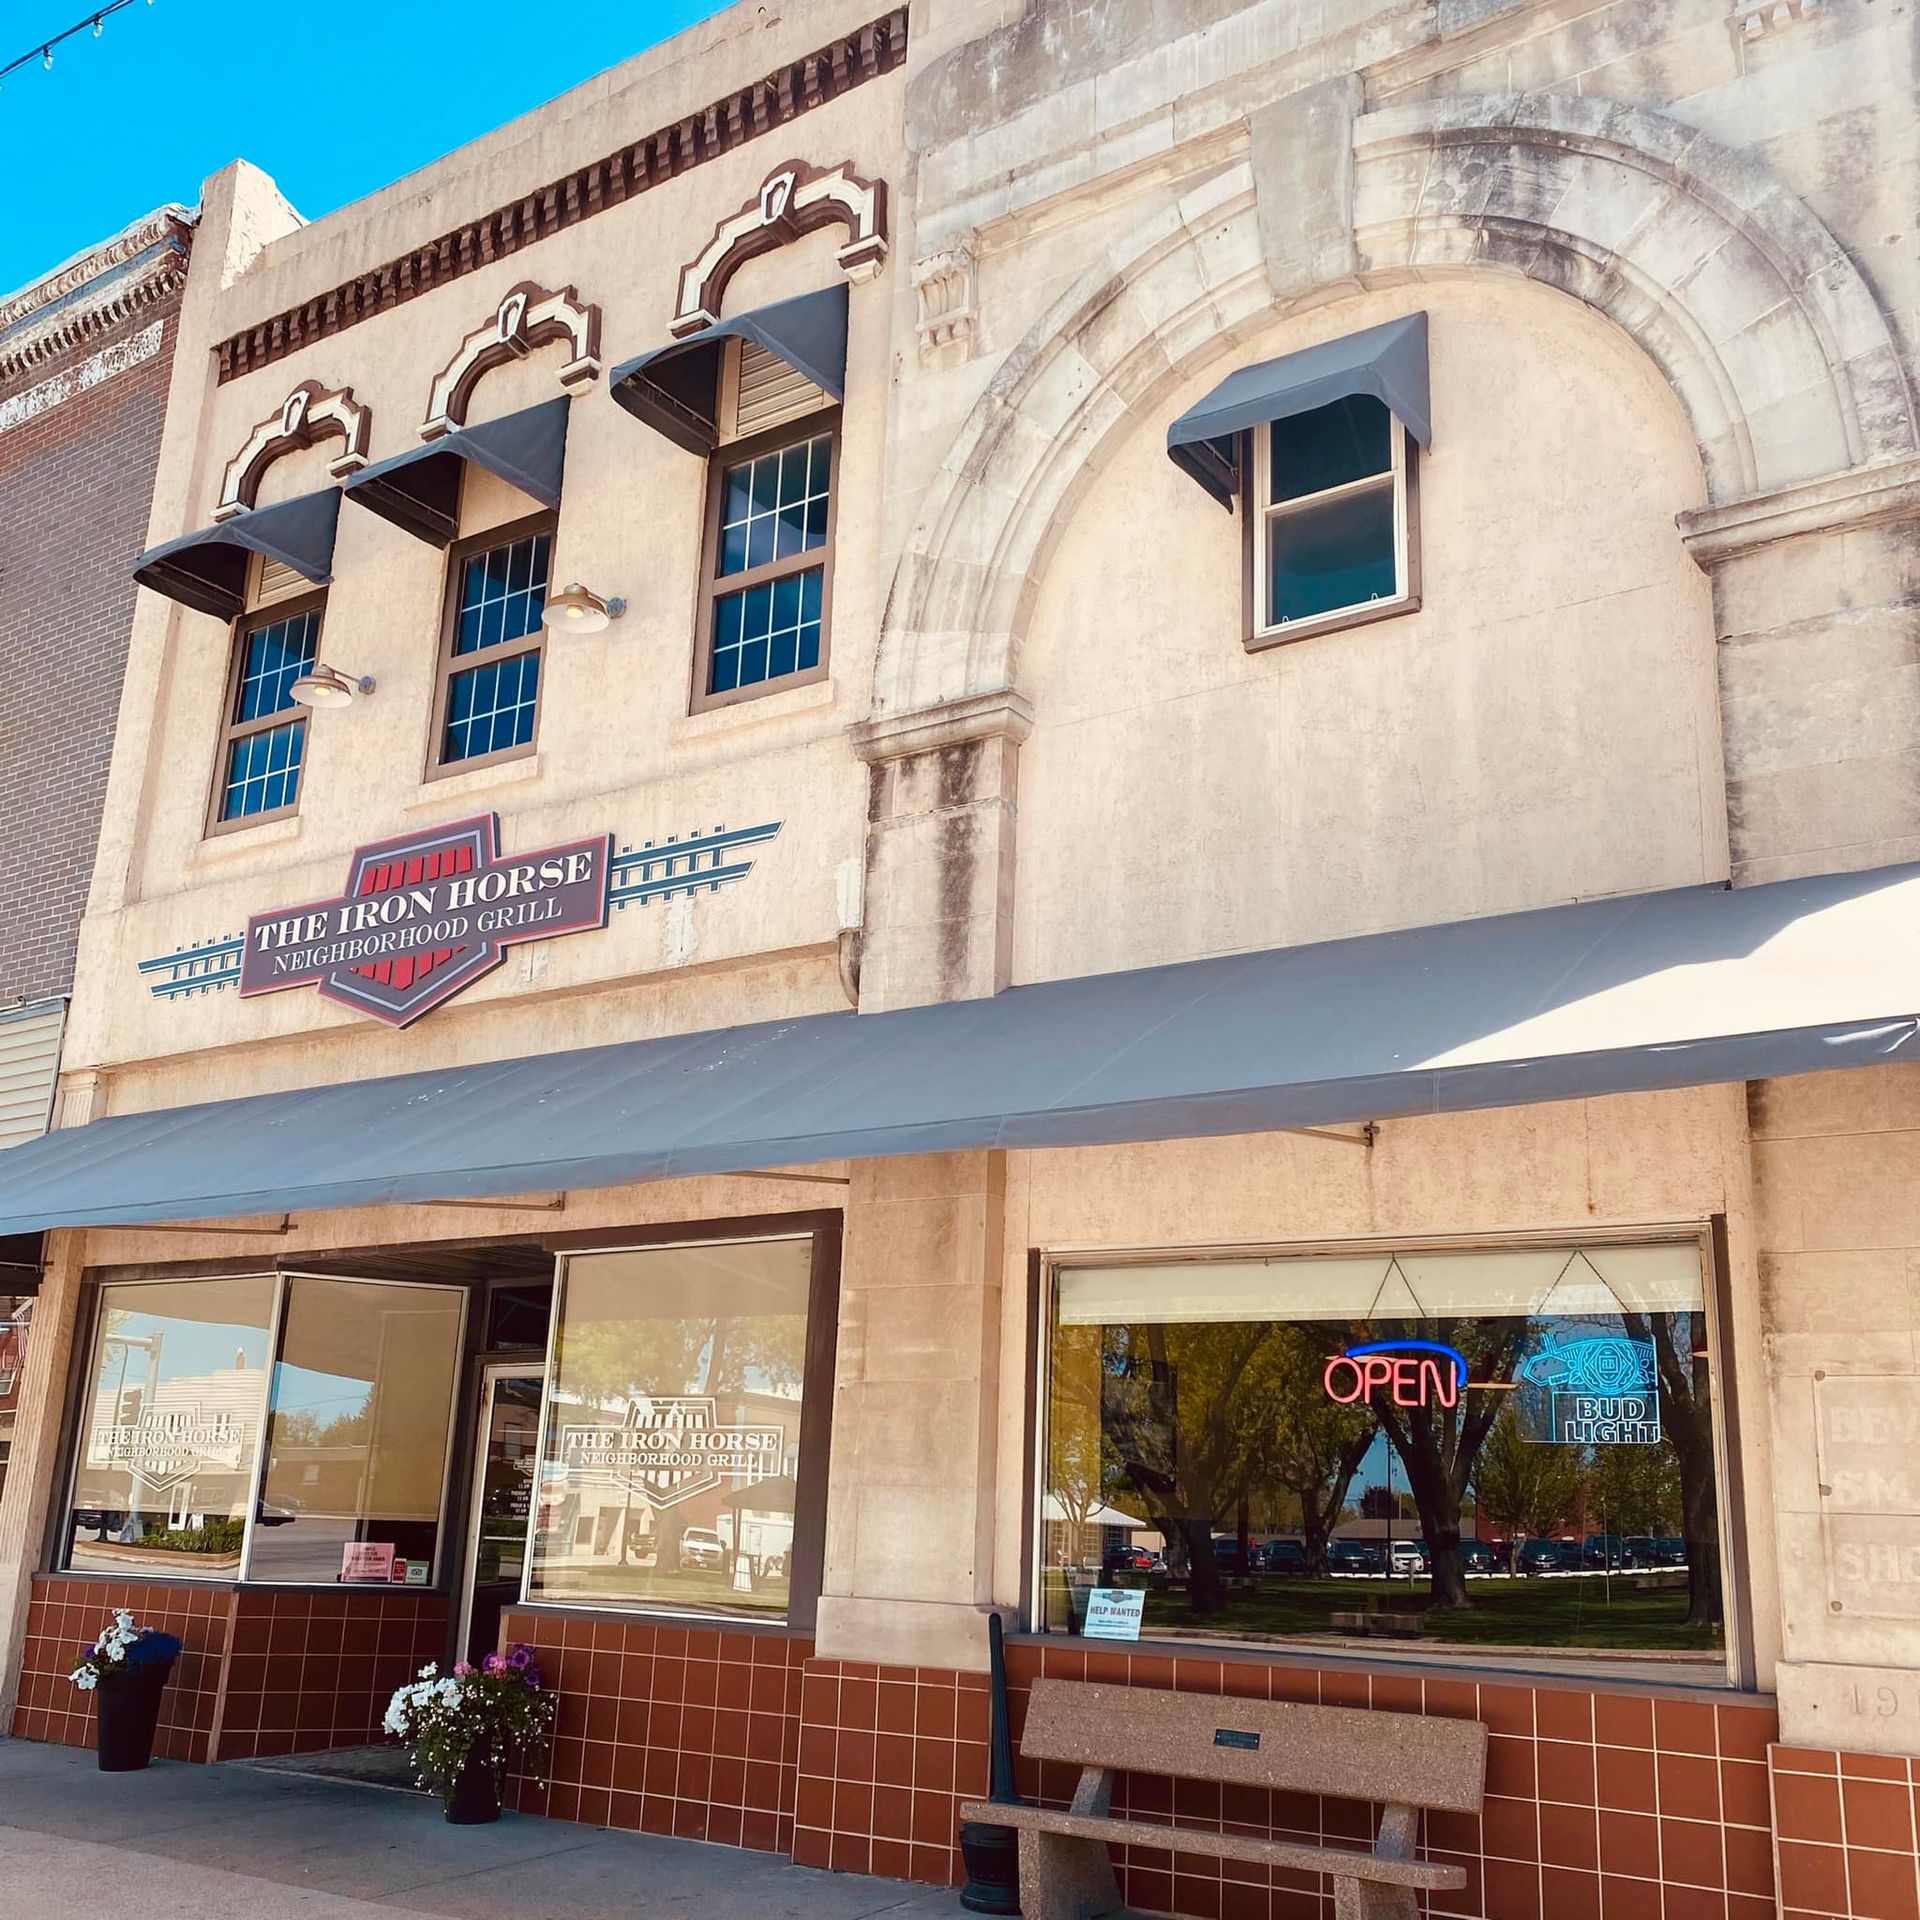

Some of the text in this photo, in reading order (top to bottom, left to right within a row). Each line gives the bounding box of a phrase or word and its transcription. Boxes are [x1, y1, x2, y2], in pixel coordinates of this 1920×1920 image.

[255, 851, 593, 953] THE IRON HORSE
[272, 897, 563, 975] NEIGHBORHOOD GRILL
[1324, 1356, 1457, 1408] OPEN
[1576, 1397, 1646, 1422] BUD
[100, 1428, 241, 1445] THE IRON HORSE
[567, 1431, 778, 1451] THE IRON HORSE
[1565, 1421, 1660, 1444] LIGHT
[580, 1452, 760, 1468] NEIGHBORHOOD GRILL
[1090, 1606, 1141, 1617] HELP WANTED
[1852, 1684, 1920, 1718] 19
